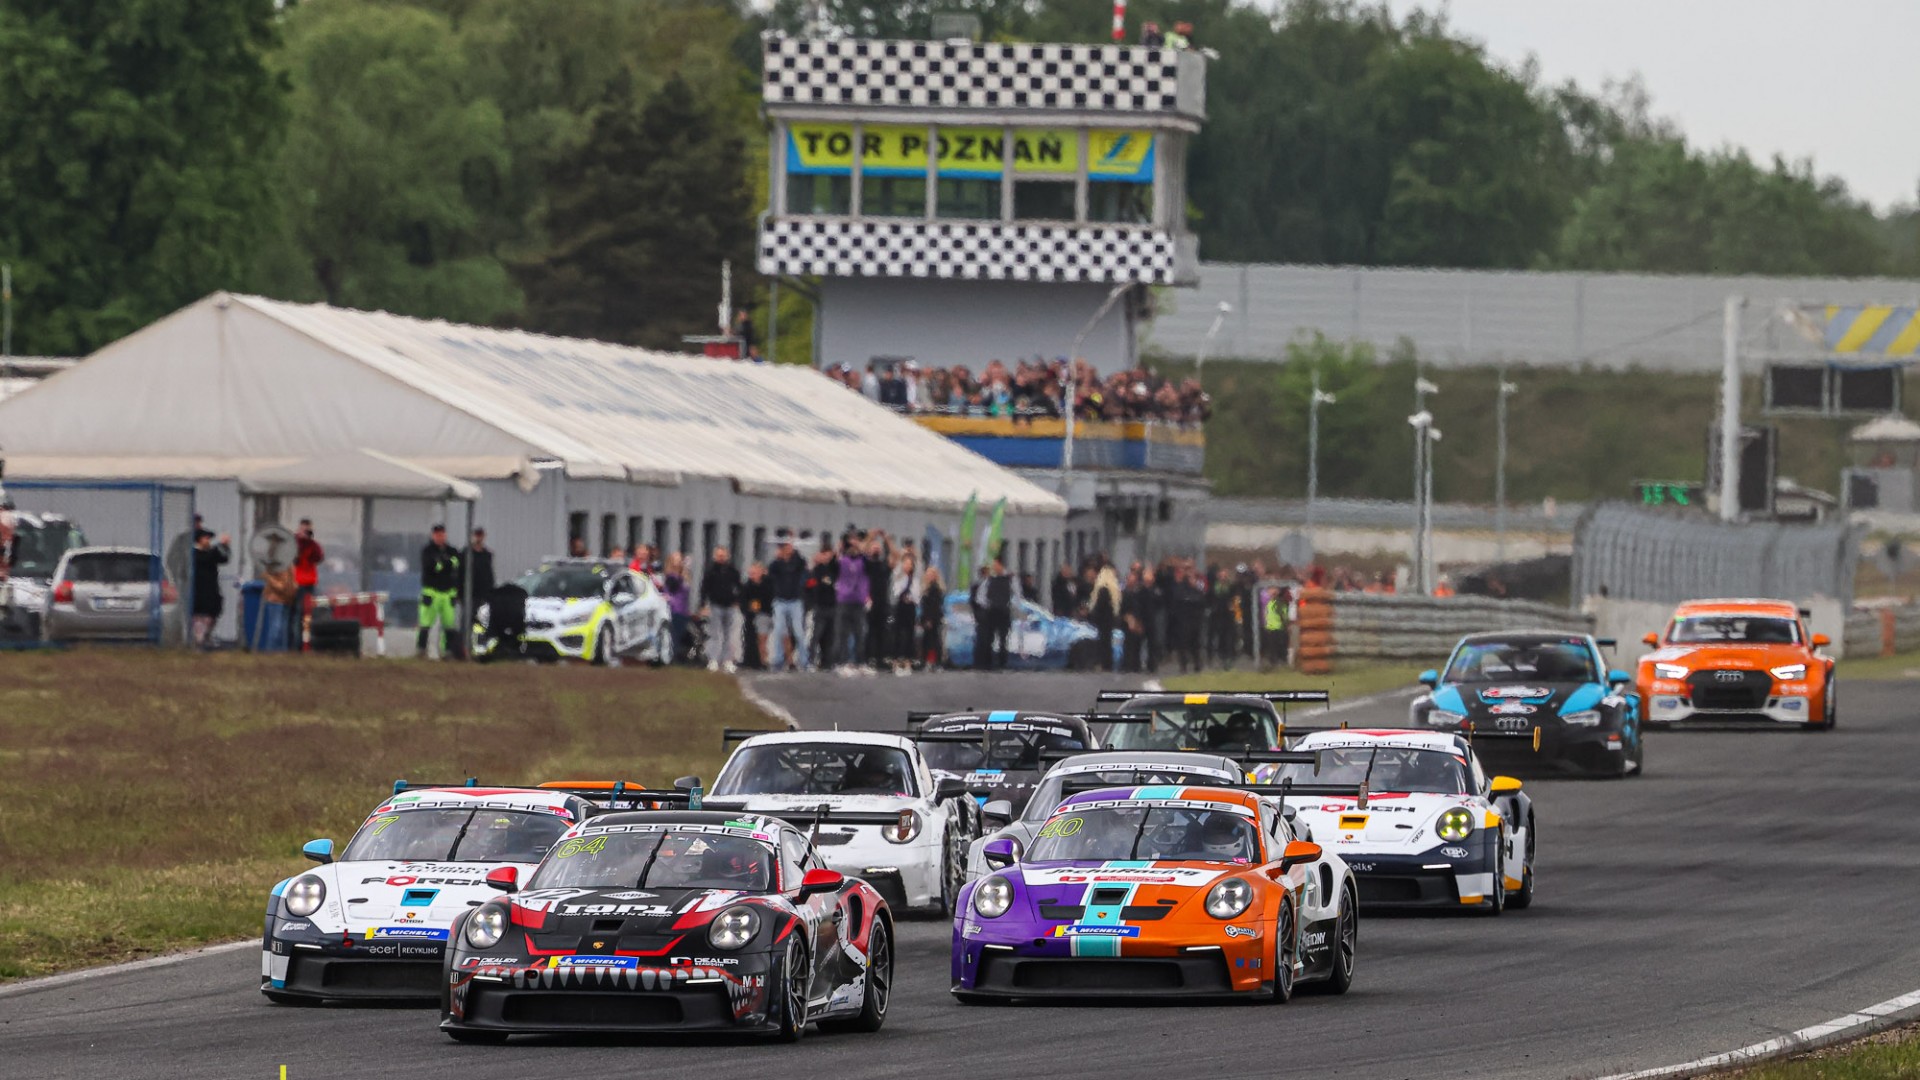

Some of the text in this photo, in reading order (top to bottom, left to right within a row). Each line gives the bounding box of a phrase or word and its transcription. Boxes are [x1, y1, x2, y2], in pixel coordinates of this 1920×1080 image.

[802, 131, 883, 158] TOR
[1308, 740, 1447, 750] PORSCHE
[1084, 763, 1197, 773] PORSCHE
[394, 800, 554, 814] PORSCHE
[1071, 800, 1234, 812] PORSCHE
[372, 815, 400, 836] 7
[1039, 817, 1085, 838] 40
[582, 824, 752, 838] PORSCHE
[557, 836, 608, 859] 64
[388, 929, 440, 938] MICHELIN
[1079, 927, 1131, 935] MICHELIN
[401, 946, 439, 955] RECYKLING
[480, 957, 518, 965] DEALER
[574, 958, 628, 966] MICHELIN
[693, 957, 739, 966] DEALER
